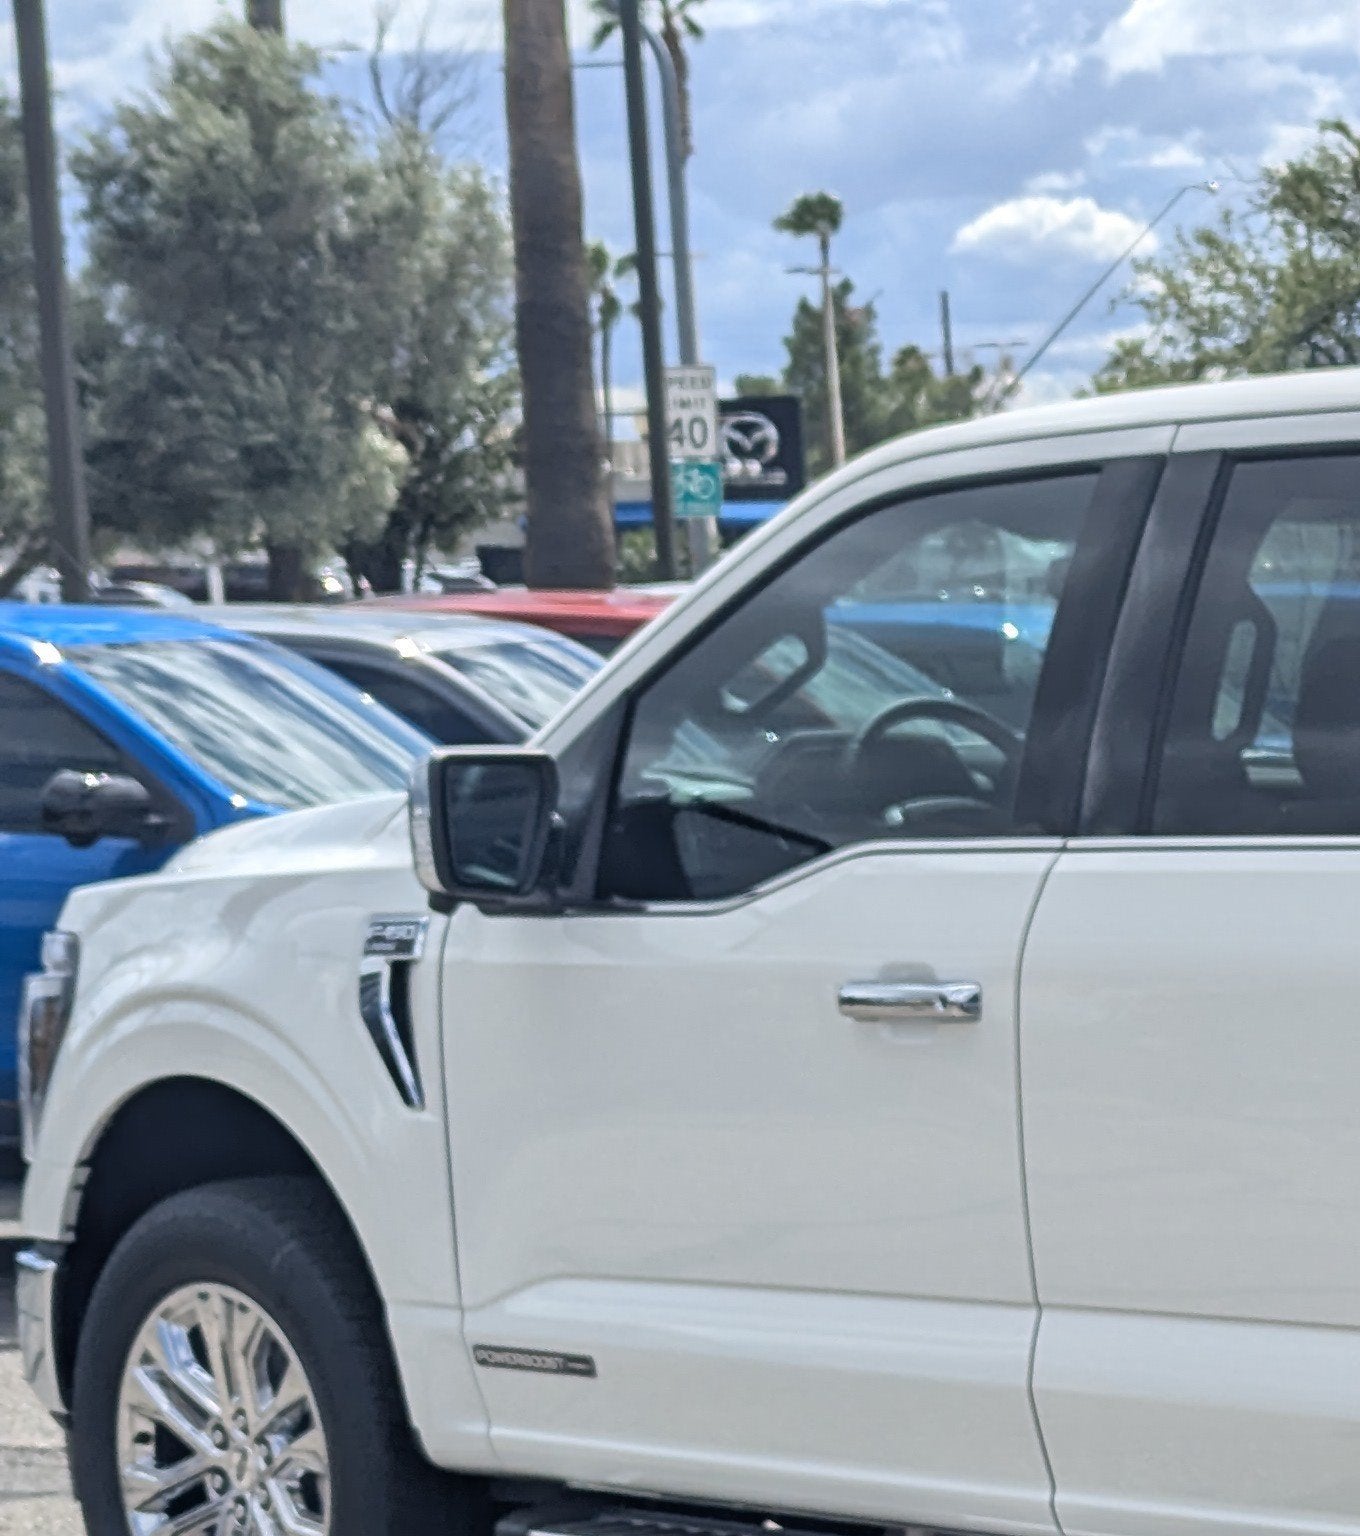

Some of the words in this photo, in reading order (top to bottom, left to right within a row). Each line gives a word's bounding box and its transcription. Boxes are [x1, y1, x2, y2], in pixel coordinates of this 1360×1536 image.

[664, 376, 711, 390] PEED
[673, 398, 707, 410] IMIT
[668, 416, 708, 449] 40
